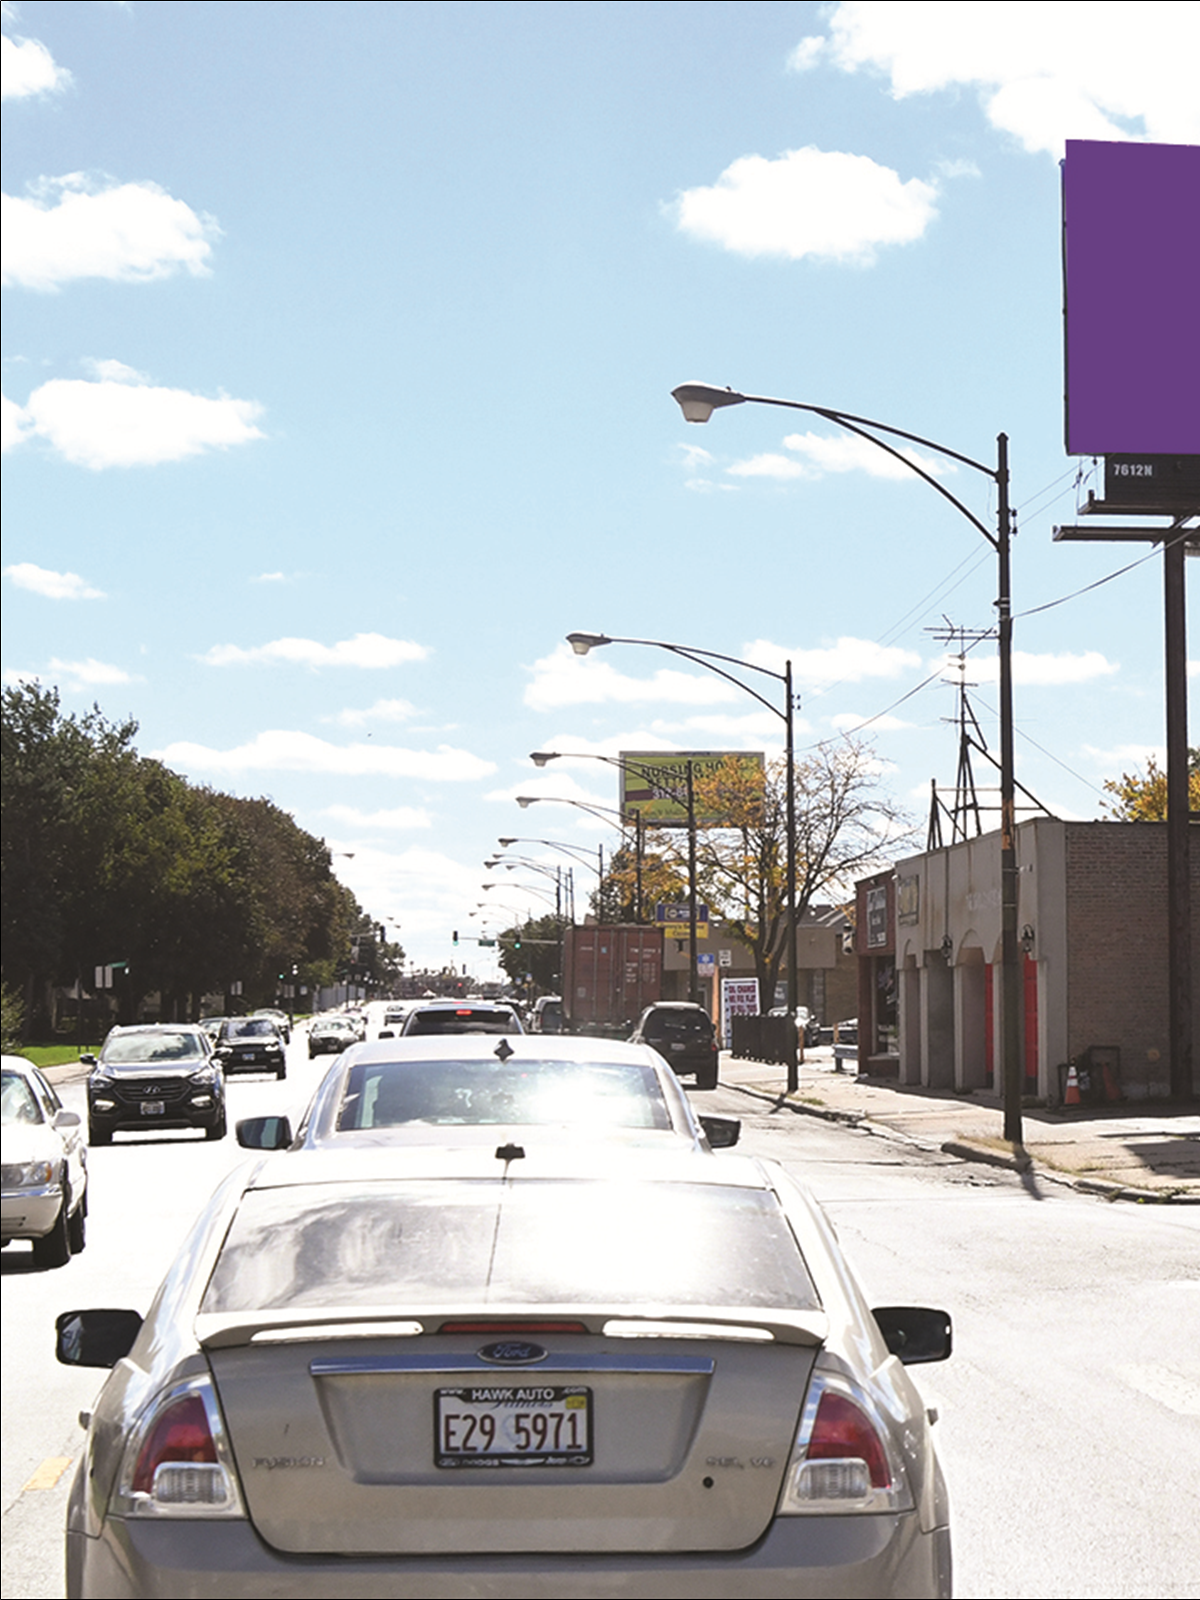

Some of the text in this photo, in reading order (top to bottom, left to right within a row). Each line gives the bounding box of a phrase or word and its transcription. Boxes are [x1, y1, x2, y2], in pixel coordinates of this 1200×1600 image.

[1113, 463, 1153, 476] 7612N
[471, 1389, 514, 1400] HAWK
[516, 1388, 555, 1400] AUTO
[444, 1412, 583, 1452] E29 5971
